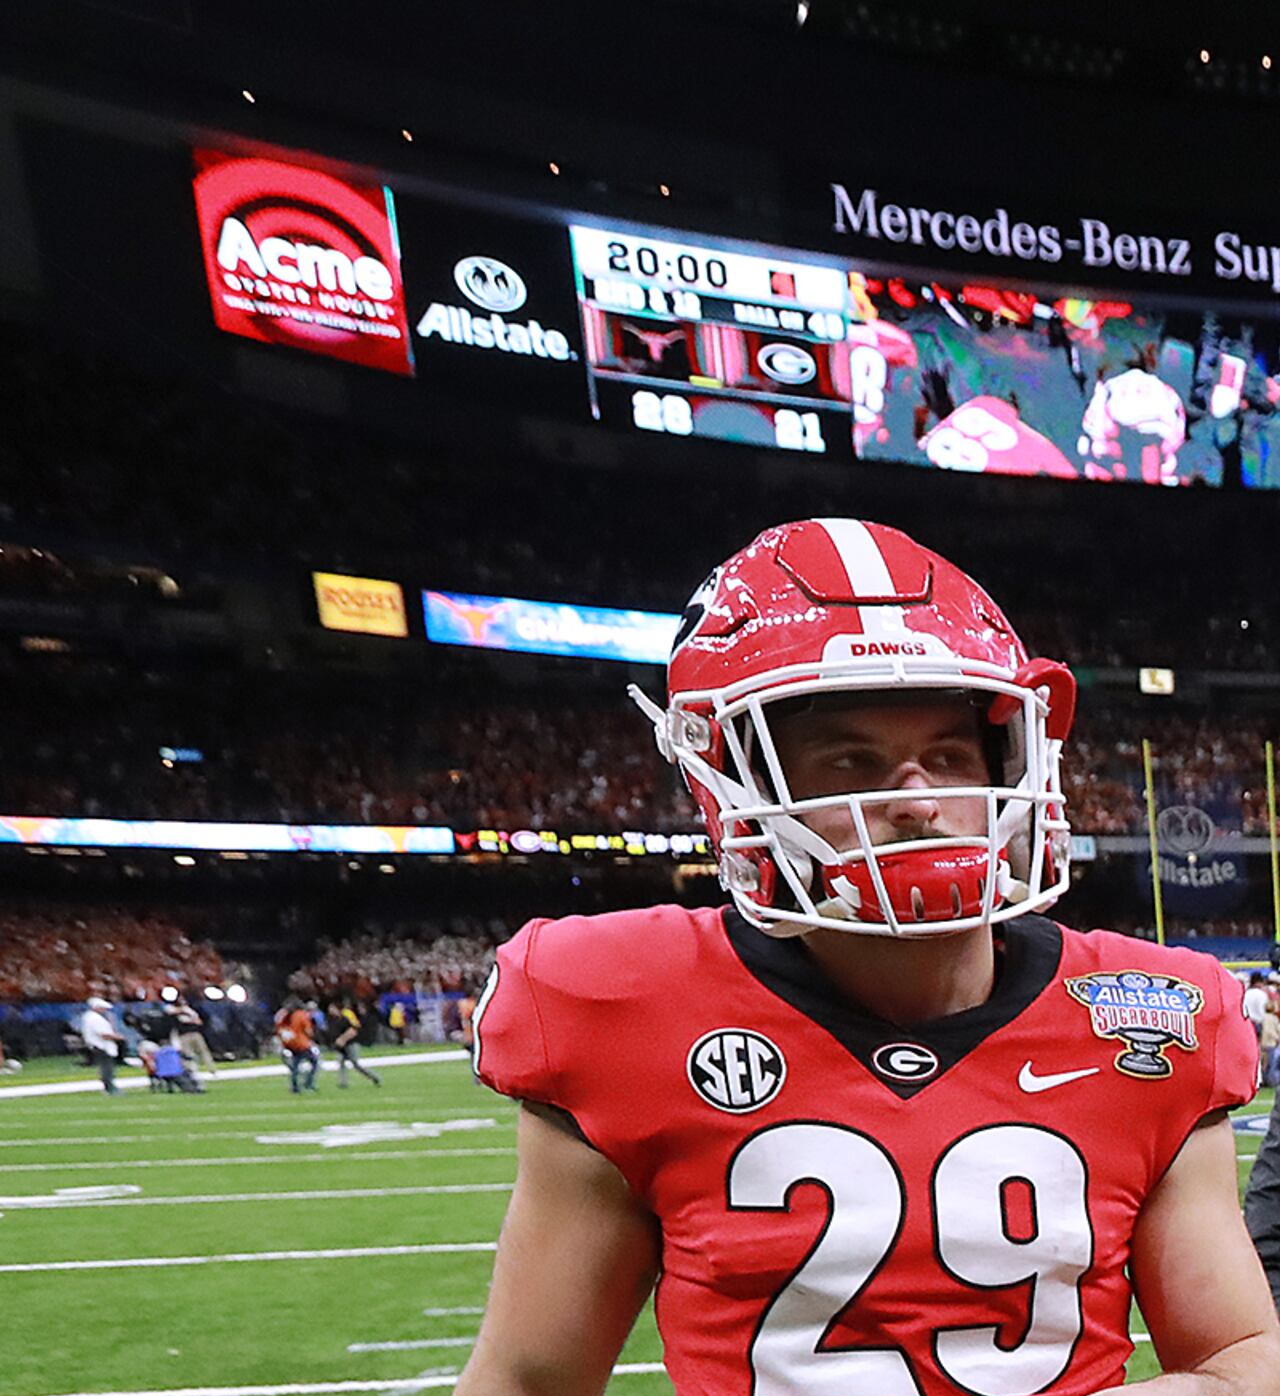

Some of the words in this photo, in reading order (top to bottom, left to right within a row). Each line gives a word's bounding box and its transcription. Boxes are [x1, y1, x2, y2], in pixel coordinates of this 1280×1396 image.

[831, 183, 1192, 275] Mercedes-Benz
[217, 216, 394, 301] Acme
[608, 242, 728, 288] 20:00
[416, 302, 571, 361] Allstate
[774, 409, 826, 452] 21
[851, 644, 927, 657] DAWGS
[1095, 986, 1182, 1010] Allstate
[695, 1034, 777, 1106] SEC
[873, 1042, 939, 1081] G
